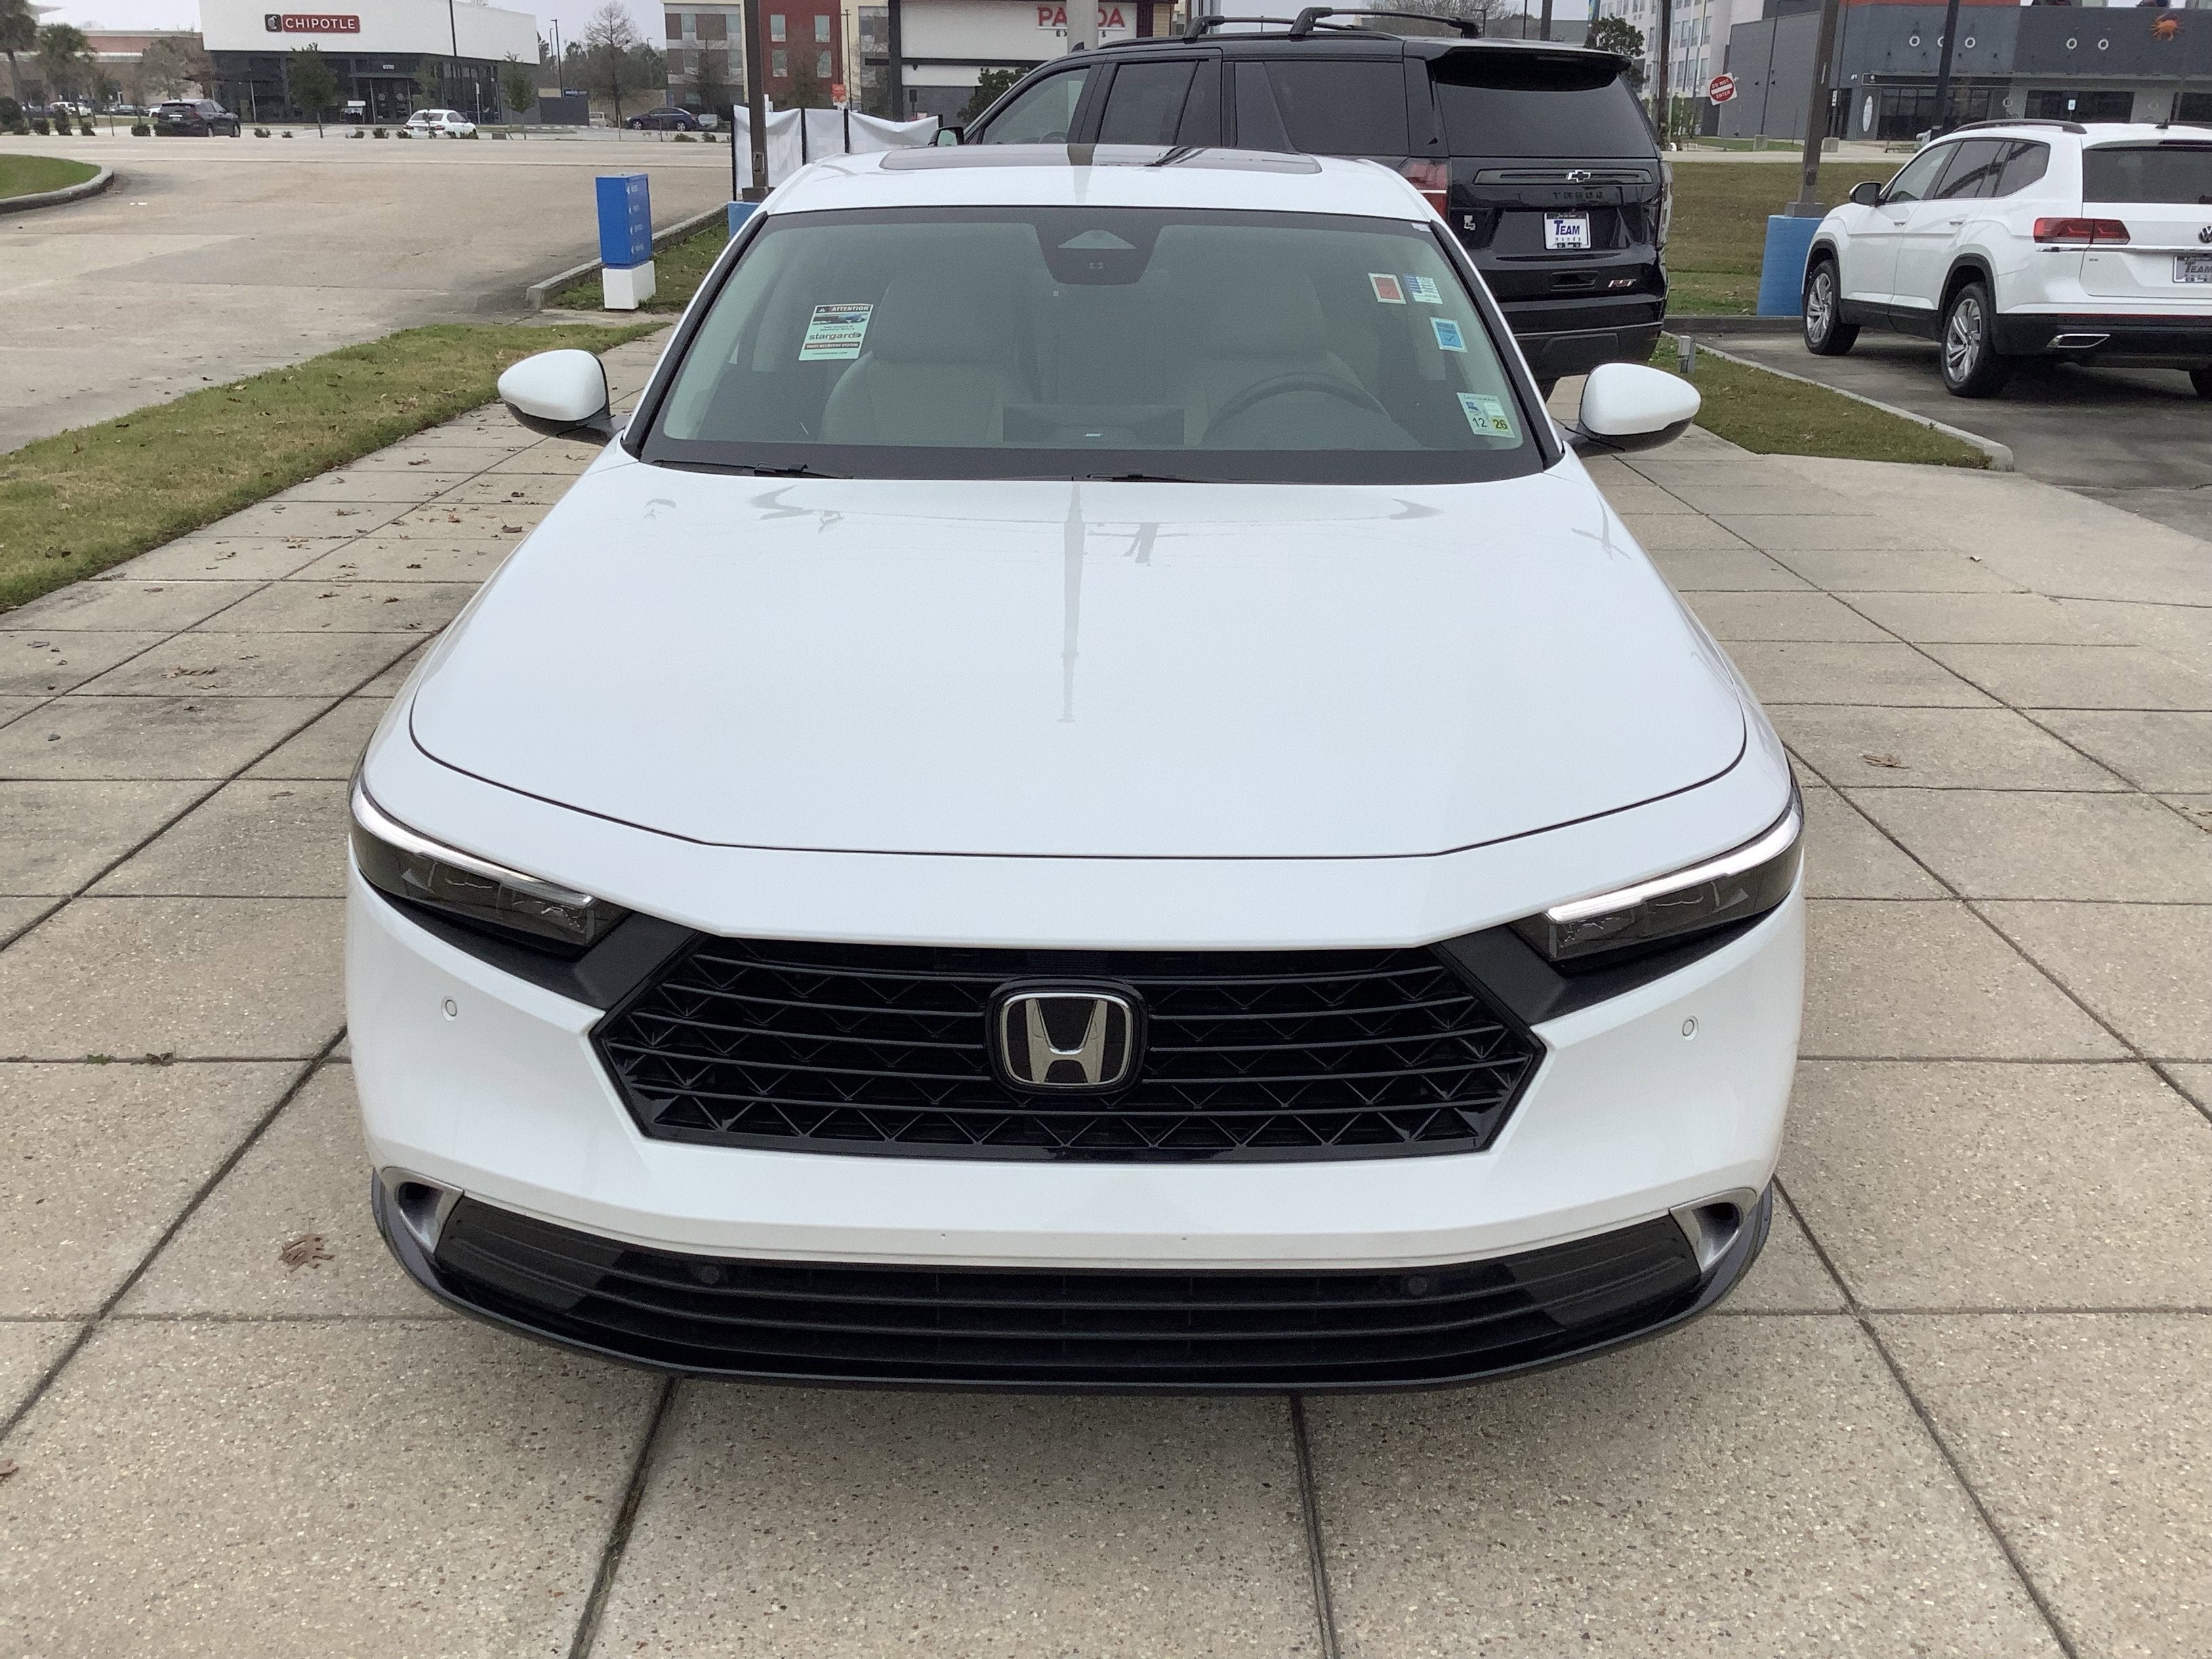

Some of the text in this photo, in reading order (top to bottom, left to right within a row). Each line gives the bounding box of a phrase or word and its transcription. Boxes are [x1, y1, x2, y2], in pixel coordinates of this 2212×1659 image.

[285, 18, 356, 29] CHIPOTLE
[1038, 7, 1125, 27] PADA
[1716, 90, 1731, 98] ENTER
[1554, 220, 1580, 235] TEAM
[1472, 417, 1509, 430] 12 26
